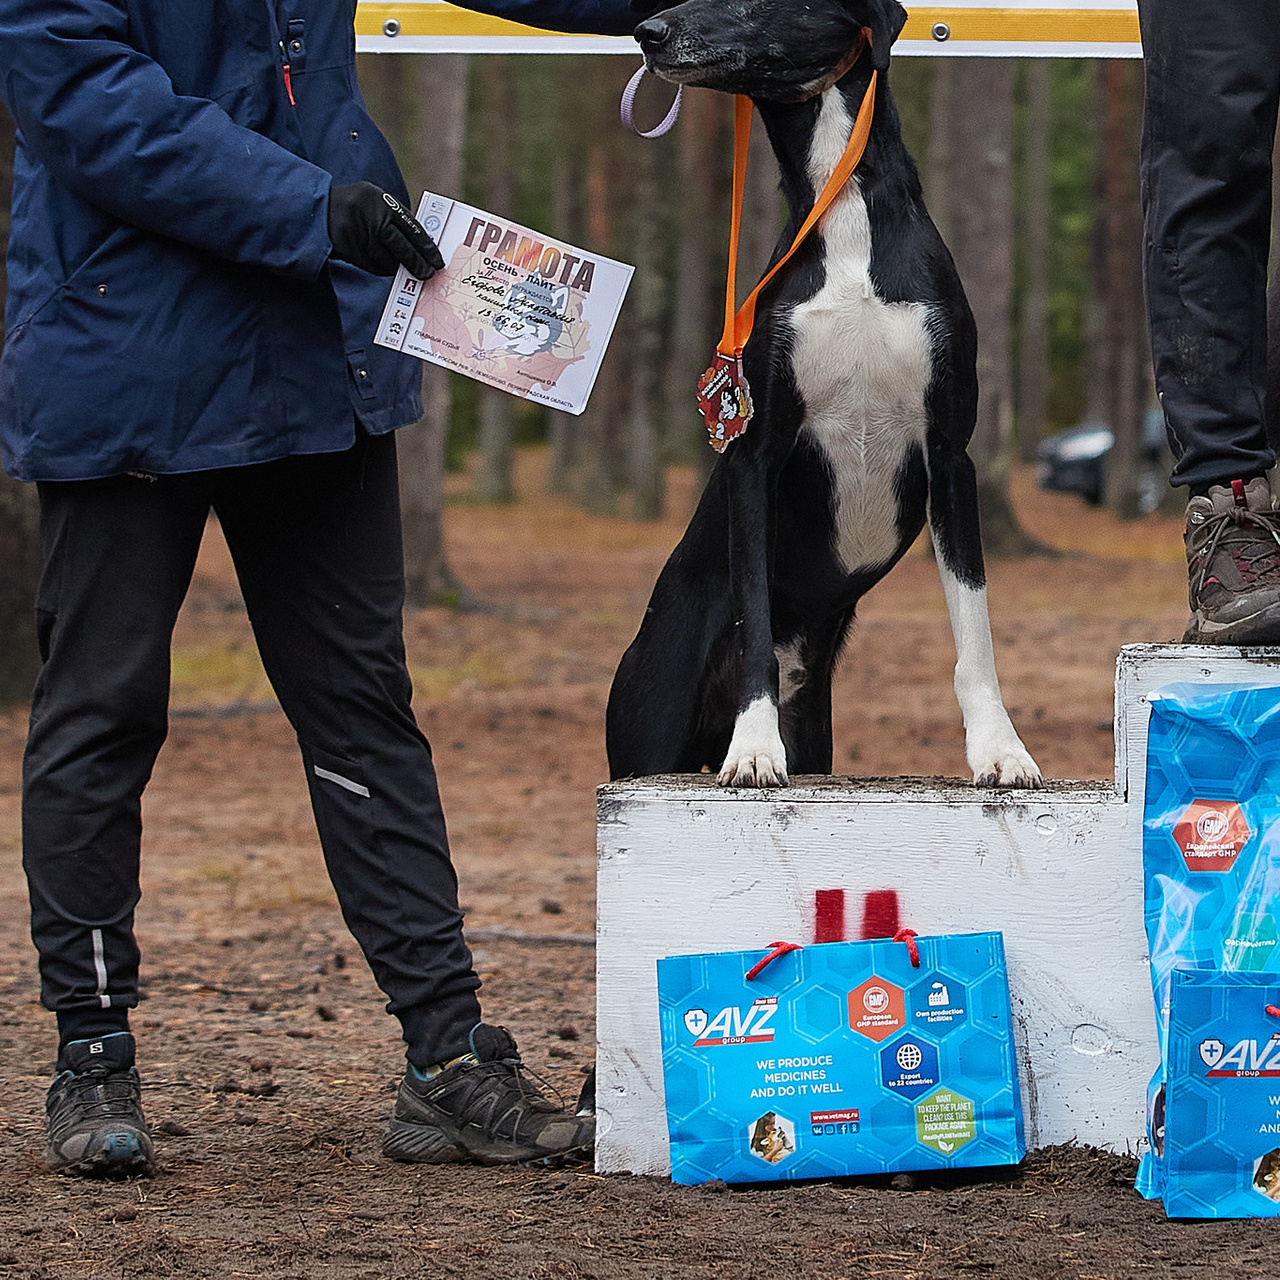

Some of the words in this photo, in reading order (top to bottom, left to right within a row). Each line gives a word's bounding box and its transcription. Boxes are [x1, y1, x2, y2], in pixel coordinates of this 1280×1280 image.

[463, 217, 595, 293] ГРАМОТА
[483, 257, 518, 277] ОСЕНЬ
[526, 273, 556, 291] ЛАЙТ
[715, 422, 725, 440] 2
[1186, 842, 1235, 851] Европейский
[1184, 849, 1217, 858] стандарт
[1218, 849, 1237, 857] GMP
[915, 1010, 930, 1018] Own
[931, 1008, 964, 1017] production
[698, 1004, 778, 1039] AVZ
[872, 1019, 899, 1027] standard
[722, 1037, 746, 1045] group
[756, 1060, 776, 1070] WE
[778, 1055, 833, 1069] PRODUCE
[764, 1070, 827, 1084] MEDICINES
[900, 1073, 921, 1081] Export
[1235, 1070, 1260, 1078] group
[905, 1078, 933, 1086] countries
[750, 1087, 775, 1099] AND
[778, 1086, 796, 1097] DO
[798, 1084, 808, 1095] IT
[810, 1082, 843, 1094] WELL
[935, 1094, 952, 1103] WANT
[917, 1105, 926, 1114] TO
[926, 1104, 940, 1113] KEEP
[940, 1103, 951, 1112] THE
[951, 1101, 971, 1112] PLANET
[812, 1111, 859, 1121] www.vetmag.ru
[944, 1112, 955, 1121] USE
[955, 1111, 968, 1120] THIS
